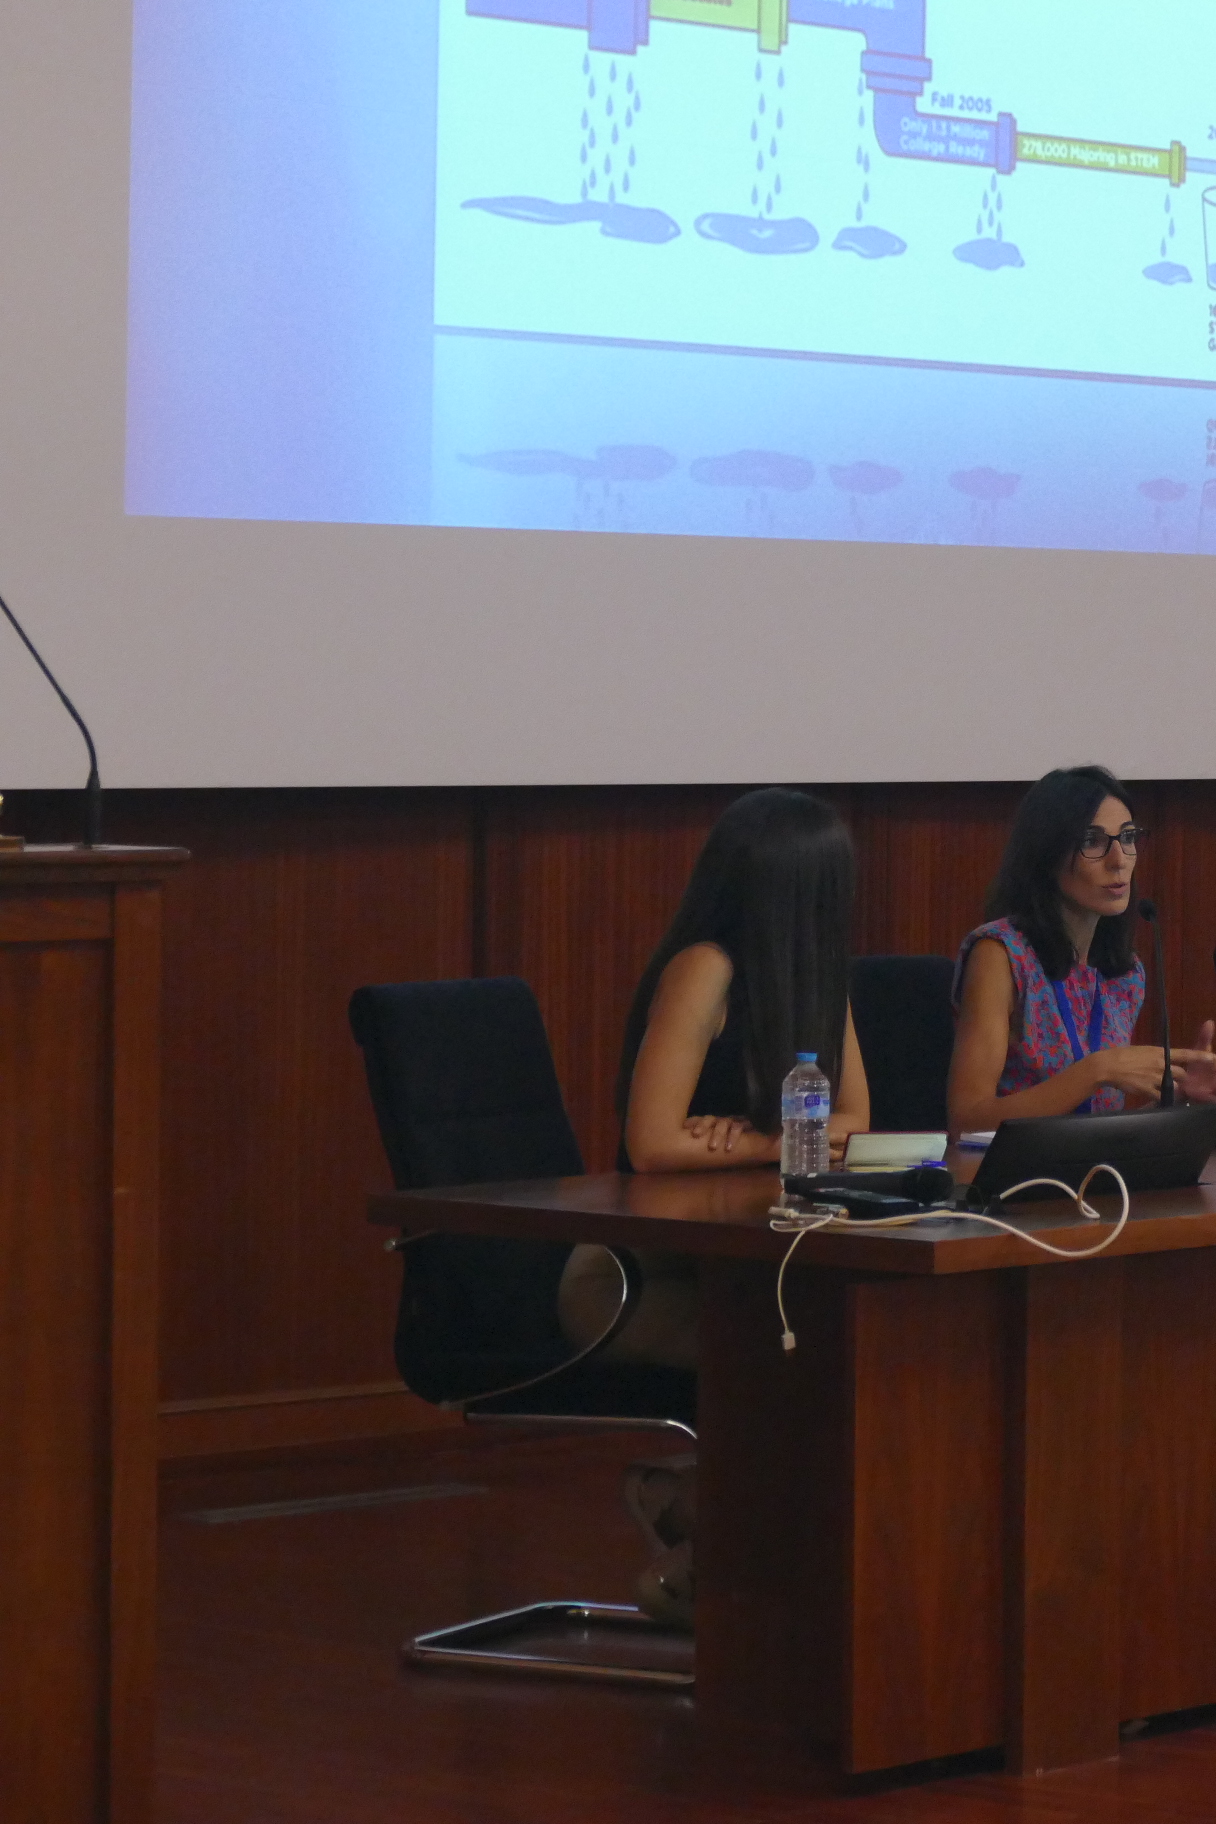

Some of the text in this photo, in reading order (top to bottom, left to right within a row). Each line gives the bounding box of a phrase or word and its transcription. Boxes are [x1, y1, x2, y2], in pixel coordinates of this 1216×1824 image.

[931, 91, 992, 114] Fall 2005
[900, 116, 928, 138] Only
[900, 134, 985, 161] College Ready
[1070, 143, 1116, 168] Majoring
[1117, 147, 1128, 166] in
[1130, 151, 1159, 169] STEM
